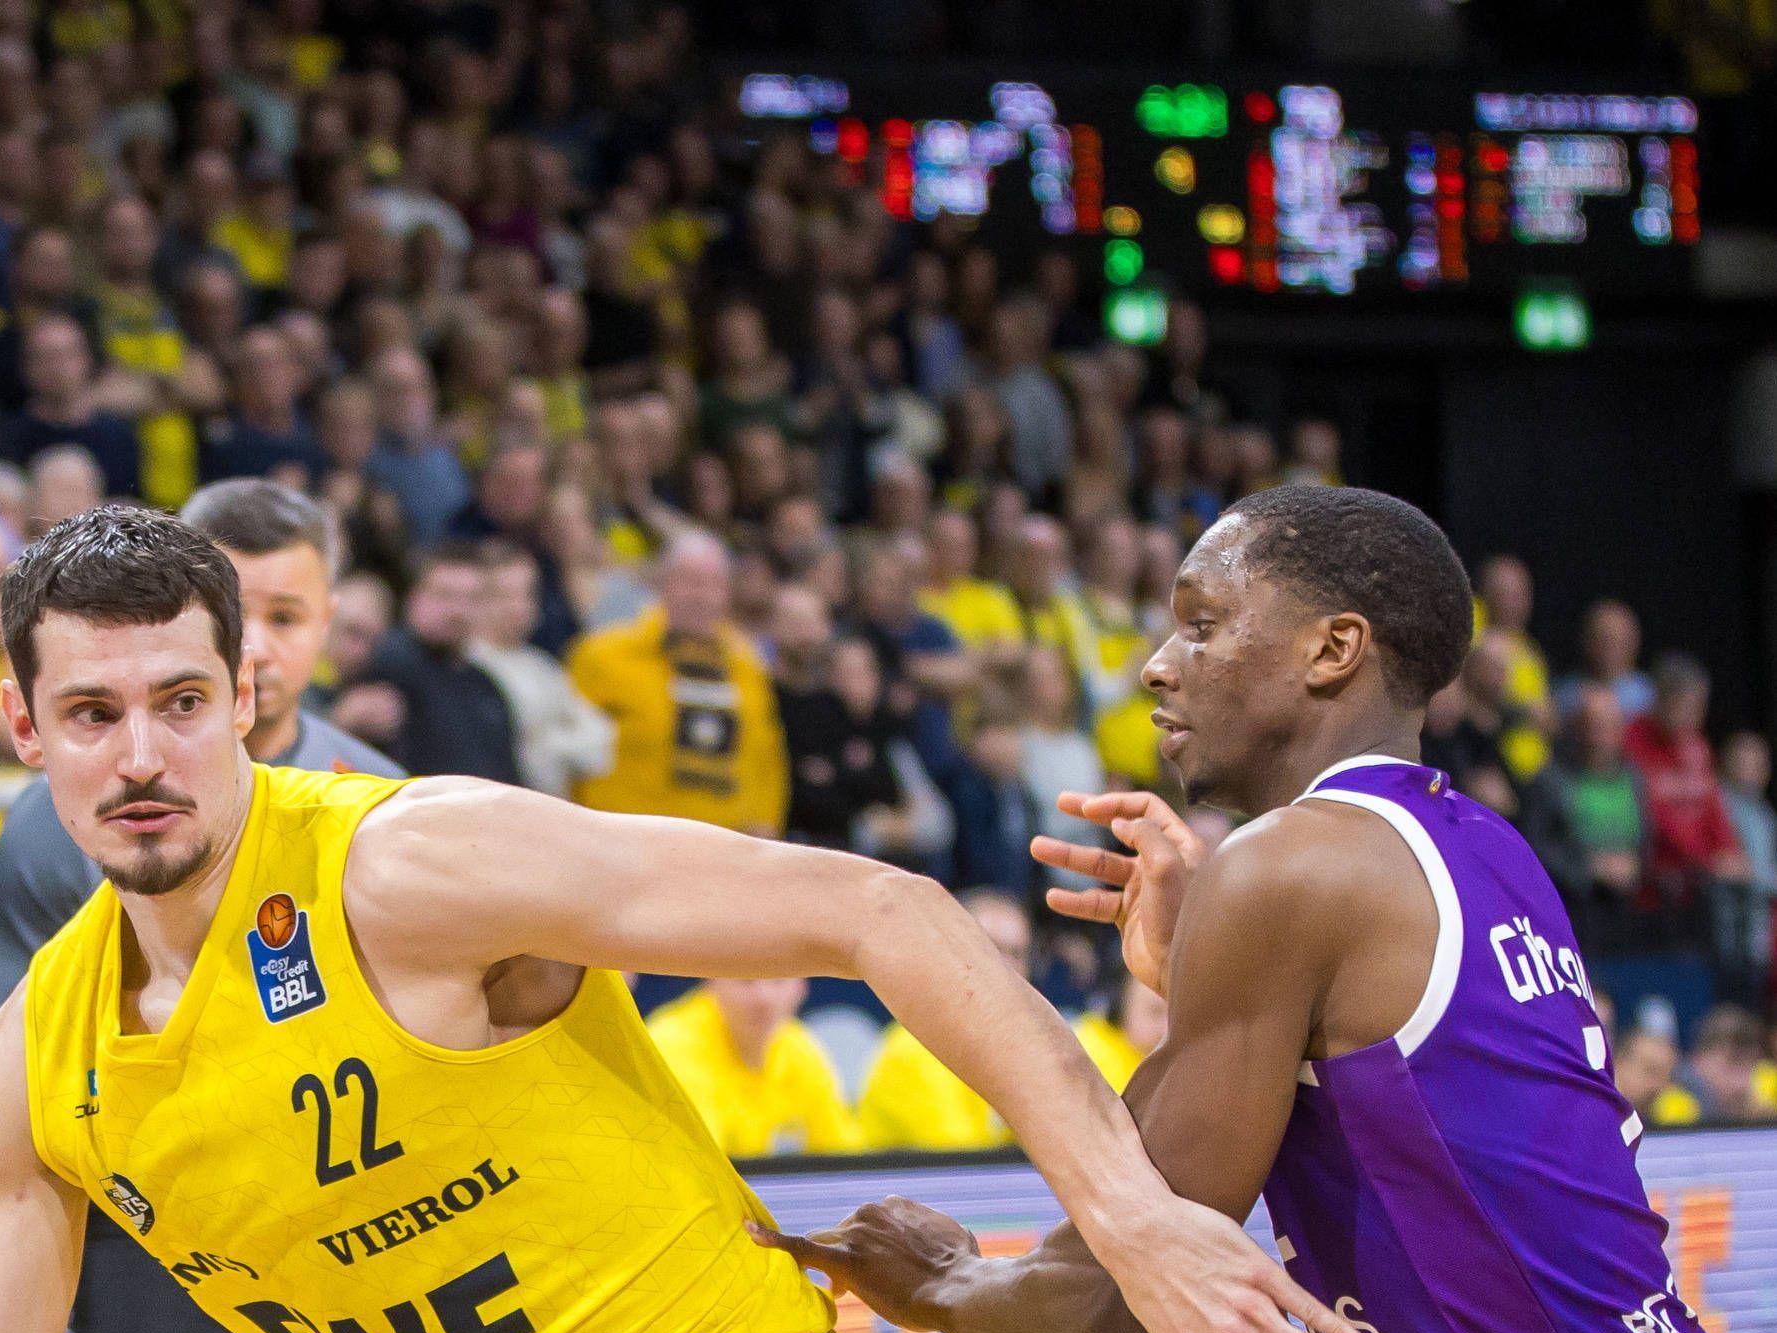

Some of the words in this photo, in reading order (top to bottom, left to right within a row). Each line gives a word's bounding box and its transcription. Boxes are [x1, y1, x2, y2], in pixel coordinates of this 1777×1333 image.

[269, 975, 317, 1013] BBL
[291, 1057, 405, 1187] 22
[316, 1158, 521, 1266] VIEROL
